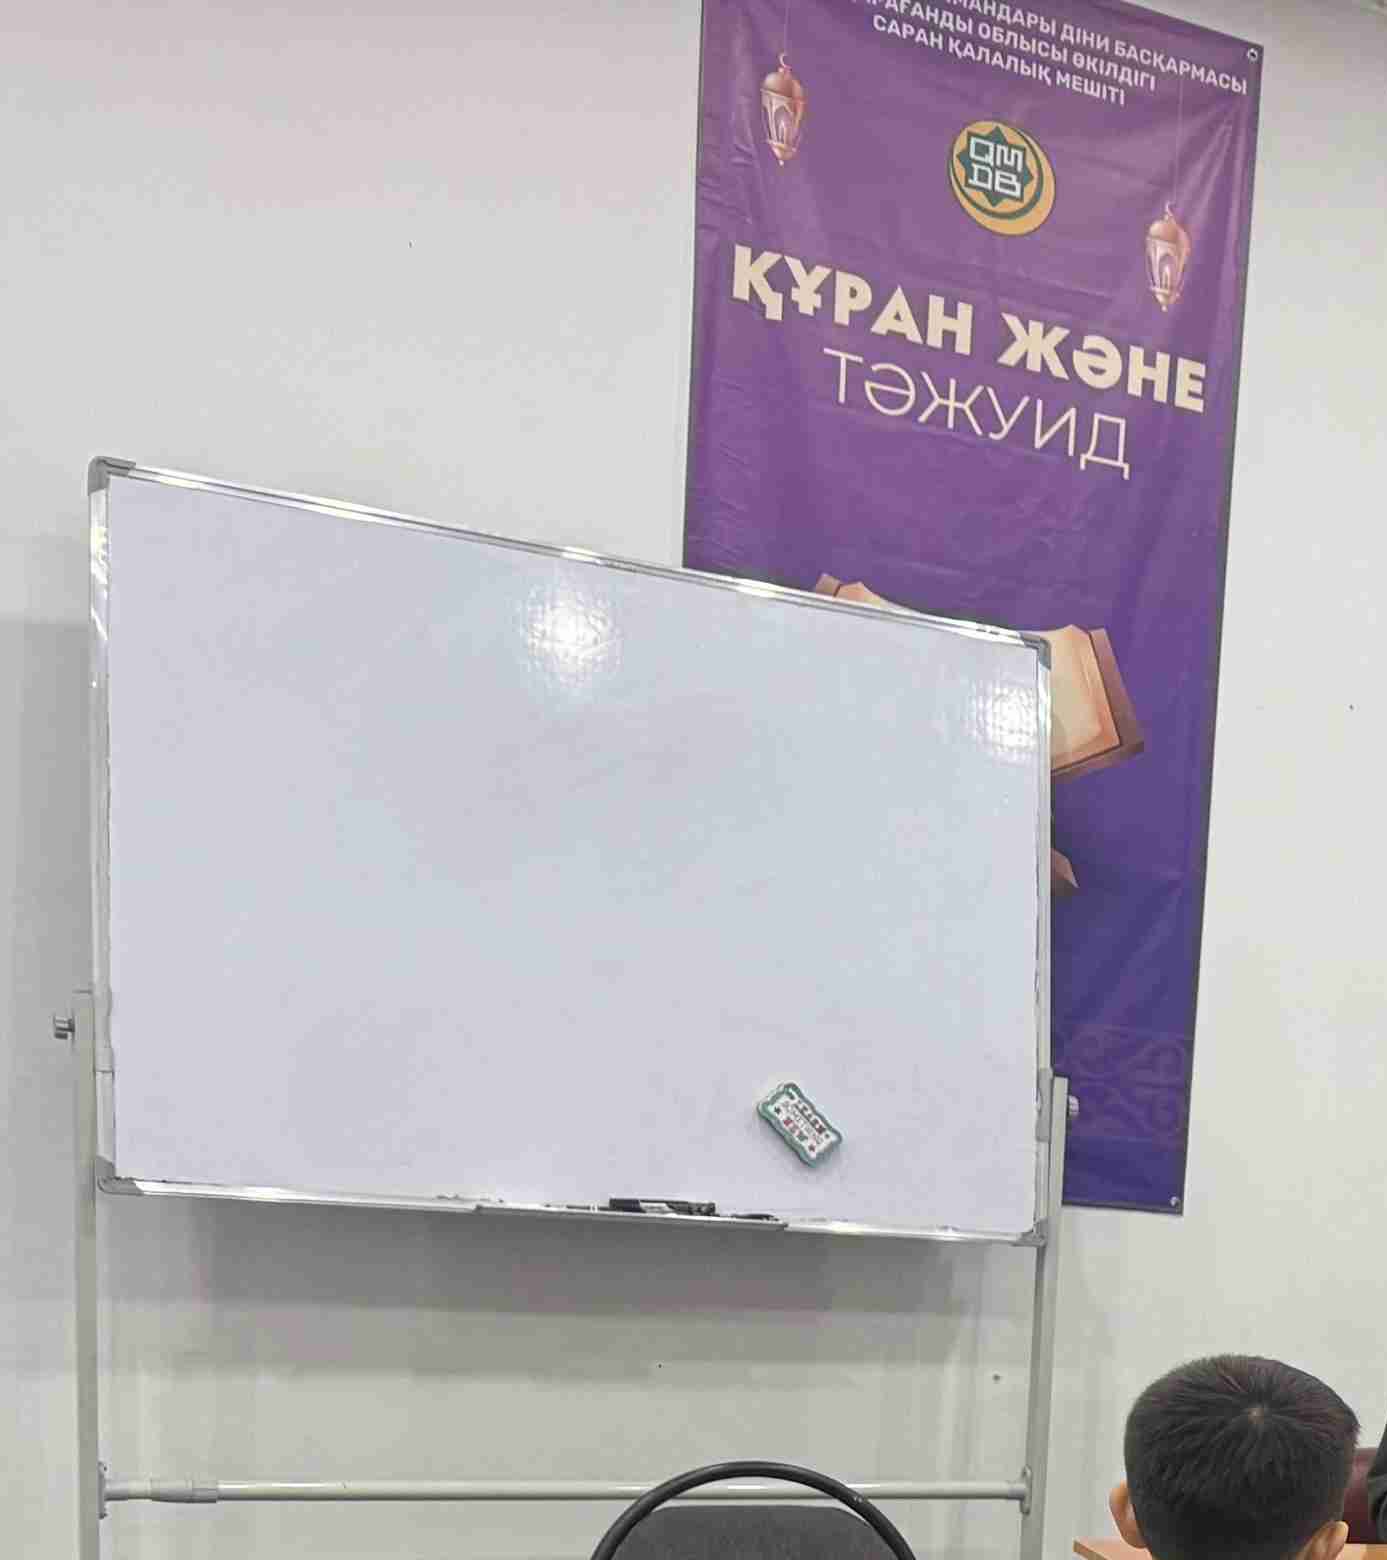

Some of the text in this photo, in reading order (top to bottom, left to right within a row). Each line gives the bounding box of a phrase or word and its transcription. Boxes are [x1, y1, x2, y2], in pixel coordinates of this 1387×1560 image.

[872, 14, 1125, 105] САРАН ҚАЛАЛЫҚ МЕШІТІ
[946, 0, 1247, 95] АНДАРЫ ДІНИ БАСҚАРМАСЫ
[978, 22, 1068, 64] ОБЛЫСЫ
[1072, 51, 1156, 91] ӨКІЛДІГІ
[732, 244, 1206, 413] ҚҰРАН ЖӘНЕ
[823, 347, 1130, 480] ТӘЖУИД
